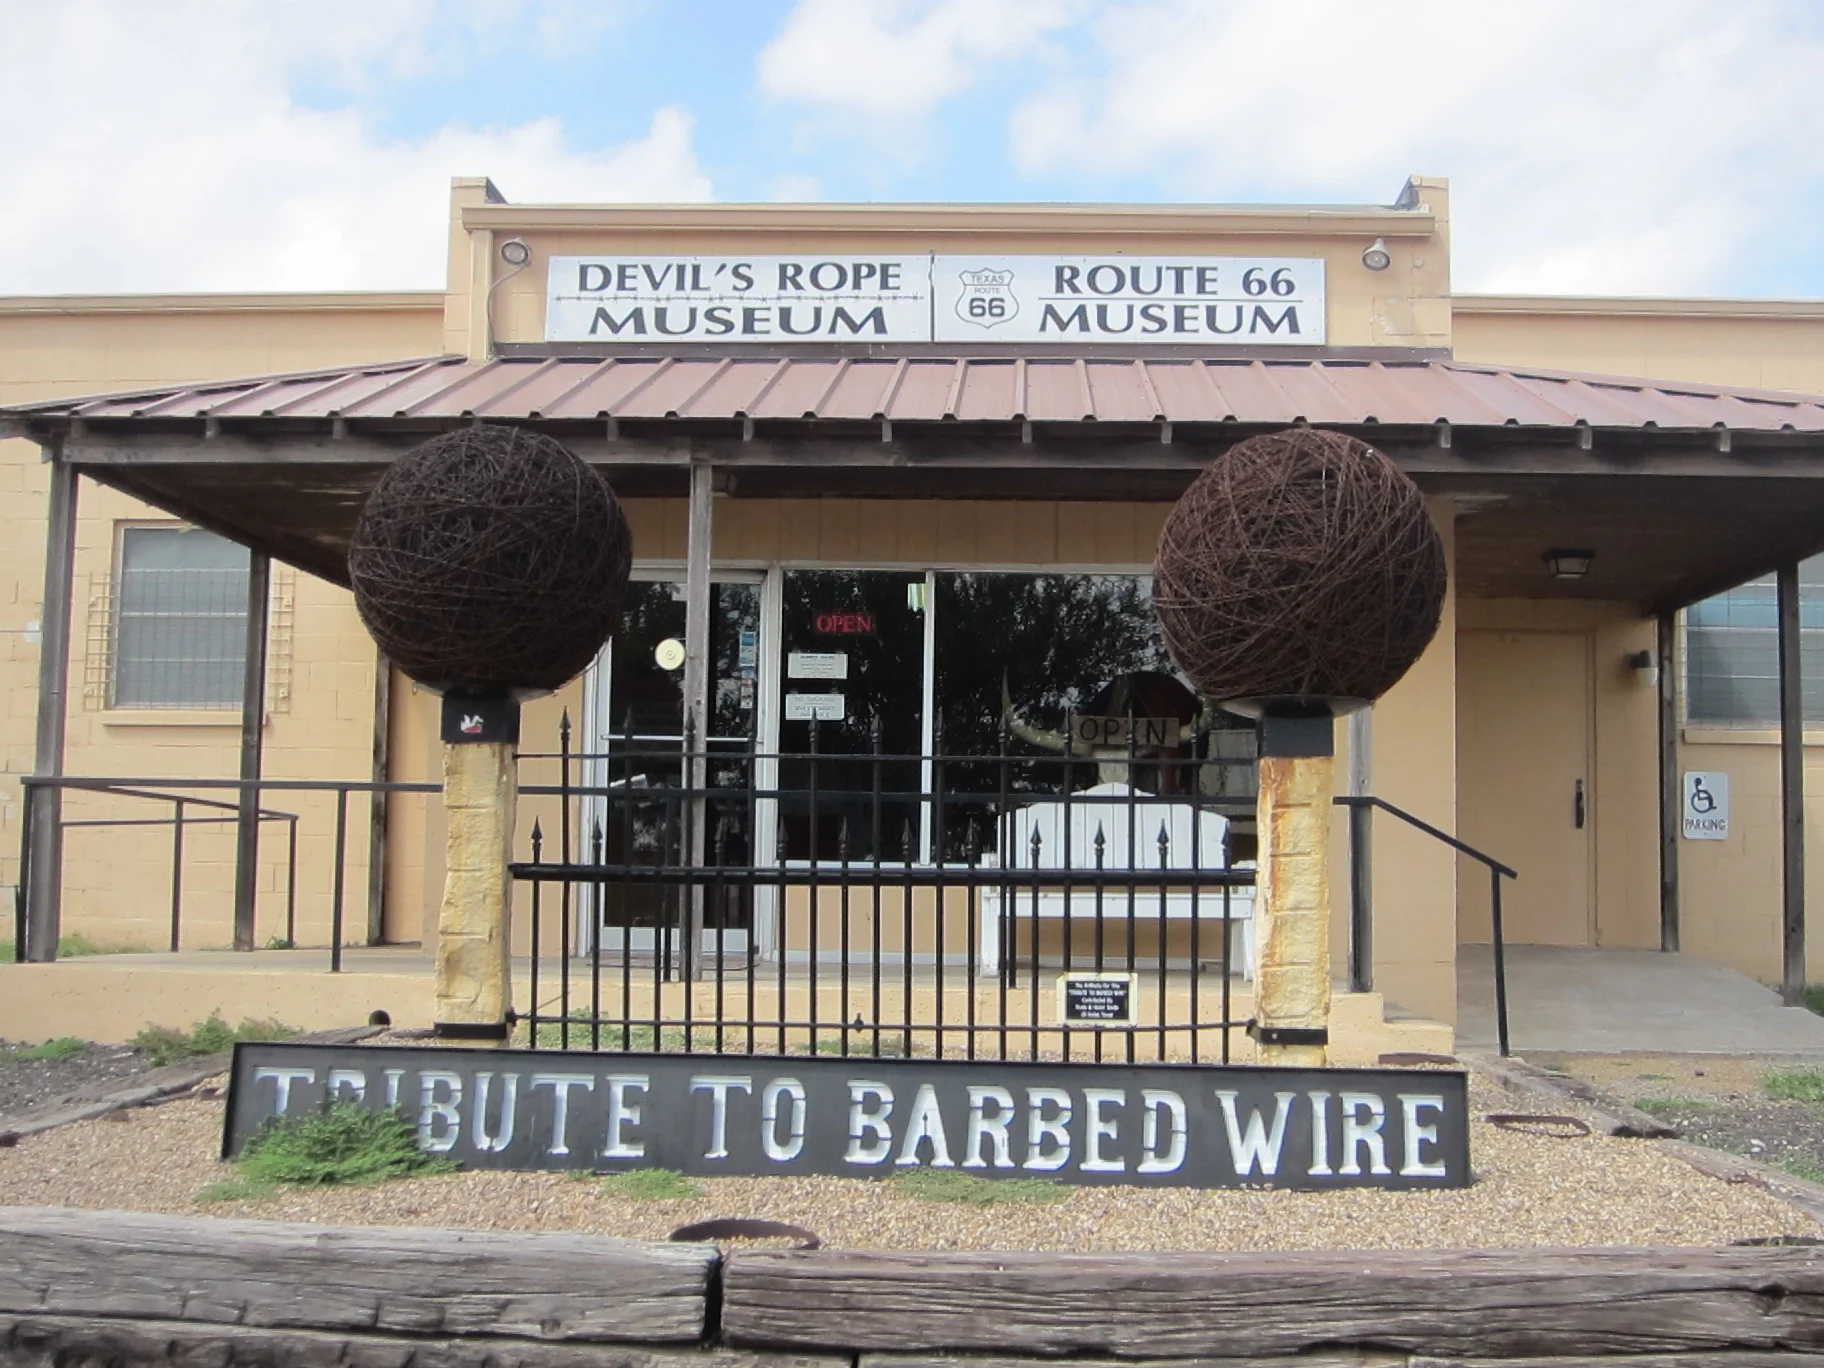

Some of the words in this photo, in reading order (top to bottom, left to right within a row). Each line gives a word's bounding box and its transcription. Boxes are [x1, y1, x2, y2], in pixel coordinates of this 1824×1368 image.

[578, 263, 754, 292] DEVIL'S
[777, 263, 902, 291] ROPE
[971, 274, 1005, 284] TEXAS
[1054, 265, 1219, 295] ROUTE
[1241, 267, 1296, 297] 66
[588, 306, 888, 335] MUSEUM
[969, 297, 1006, 317] 66
[1038, 303, 1301, 335] MUSEUM
[816, 615, 872, 632] OPEN
[1080, 718, 1167, 744] OPN
[1685, 818, 1726, 831] PARKING
[689, 1076, 807, 1162] TO
[843, 1080, 1188, 1174] BARBED
[1214, 1090, 1447, 1178] WIRE
